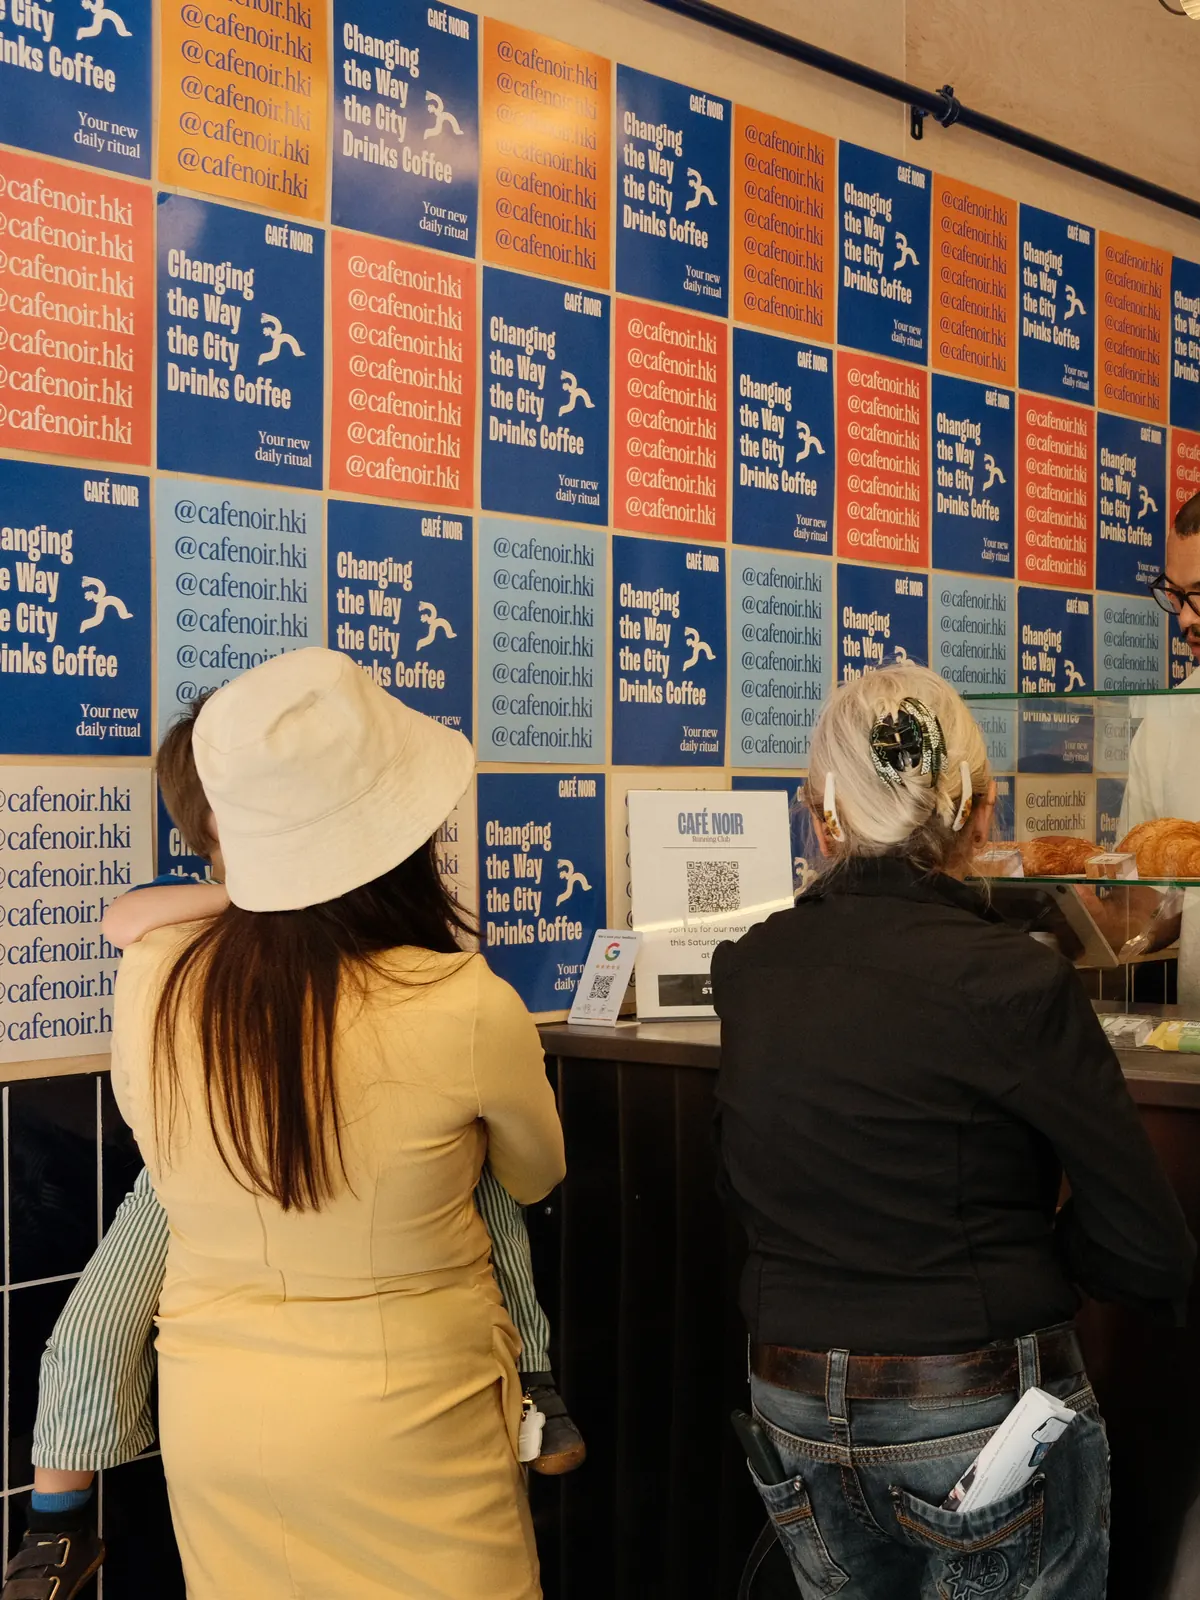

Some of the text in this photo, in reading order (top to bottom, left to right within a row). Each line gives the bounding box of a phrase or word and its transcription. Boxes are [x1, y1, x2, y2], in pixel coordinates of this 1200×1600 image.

[427, 7, 469, 40] CAFÉ NOIR
[343, 22, 419, 78] Changing
[496, 40, 597, 90] @cafenoir.hki
[49, 46, 116, 93] Coffee
[343, 59, 408, 108] the Way
[343, 93, 407, 143] the City
[689, 94, 723, 120] CAFÉ NOIR
[624, 111, 683, 157] Changing
[744, 124, 824, 166] @cafenoir.hki
[343, 128, 452, 184] Drinks Coffee
[623, 142, 674, 184] the Way
[177, 147, 307, 200] @cafenoir.hki
[623, 173, 672, 215] the City
[941, 190, 1007, 226] @cafenoir.hki
[419, 216, 468, 240] daily ritual
[422, 200, 468, 224] Your new
[623, 204, 708, 248] Drinks Coffee
[265, 223, 313, 254] CAFÉ NOIR
[495, 228, 596, 270] @cafenoir.hki
[1067, 224, 1090, 245] CAFÉ NOIR
[168, 248, 254, 301] Changing
[1023, 240, 1063, 276] Changing
[347, 255, 462, 299] @cafenoir.hki
[1023, 266, 1057, 299] the Way
[166, 286, 241, 335] the Way
[1023, 291, 1056, 324] the City
[166, 324, 239, 371] the City
[627, 318, 717, 354] @cafenoir.hki
[1023, 316, 1080, 350] Drinks Coffee
[167, 362, 291, 409] Drinks Coffee
[348, 354, 462, 395] @cafenoir.hki
[847, 367, 920, 399] @cafenoir.hki
[1025, 408, 1087, 436] @cafenoir.hki
[254, 446, 312, 467] daily ritual
[258, 430, 310, 450] Your new
[174, 499, 306, 534] @cafenoir.hki
[625, 496, 716, 526] @cafenoir.hki
[493, 537, 594, 567] @cafenoir.hki
[685, 549, 719, 572] CAFÉ NOIR
[741, 566, 822, 592] @cafenoir.hki
[619, 582, 680, 618] Changing
[619, 614, 671, 648] the Way
[619, 645, 669, 679] the City
[619, 677, 706, 705] Drinks Coffee
[491, 723, 592, 748] @cafenoir.hki
[679, 739, 719, 754] daily ritual
[682, 725, 718, 738] Your new
[677, 808, 744, 835] CAFÉ NOIR
[692, 835, 731, 844] Running Club
